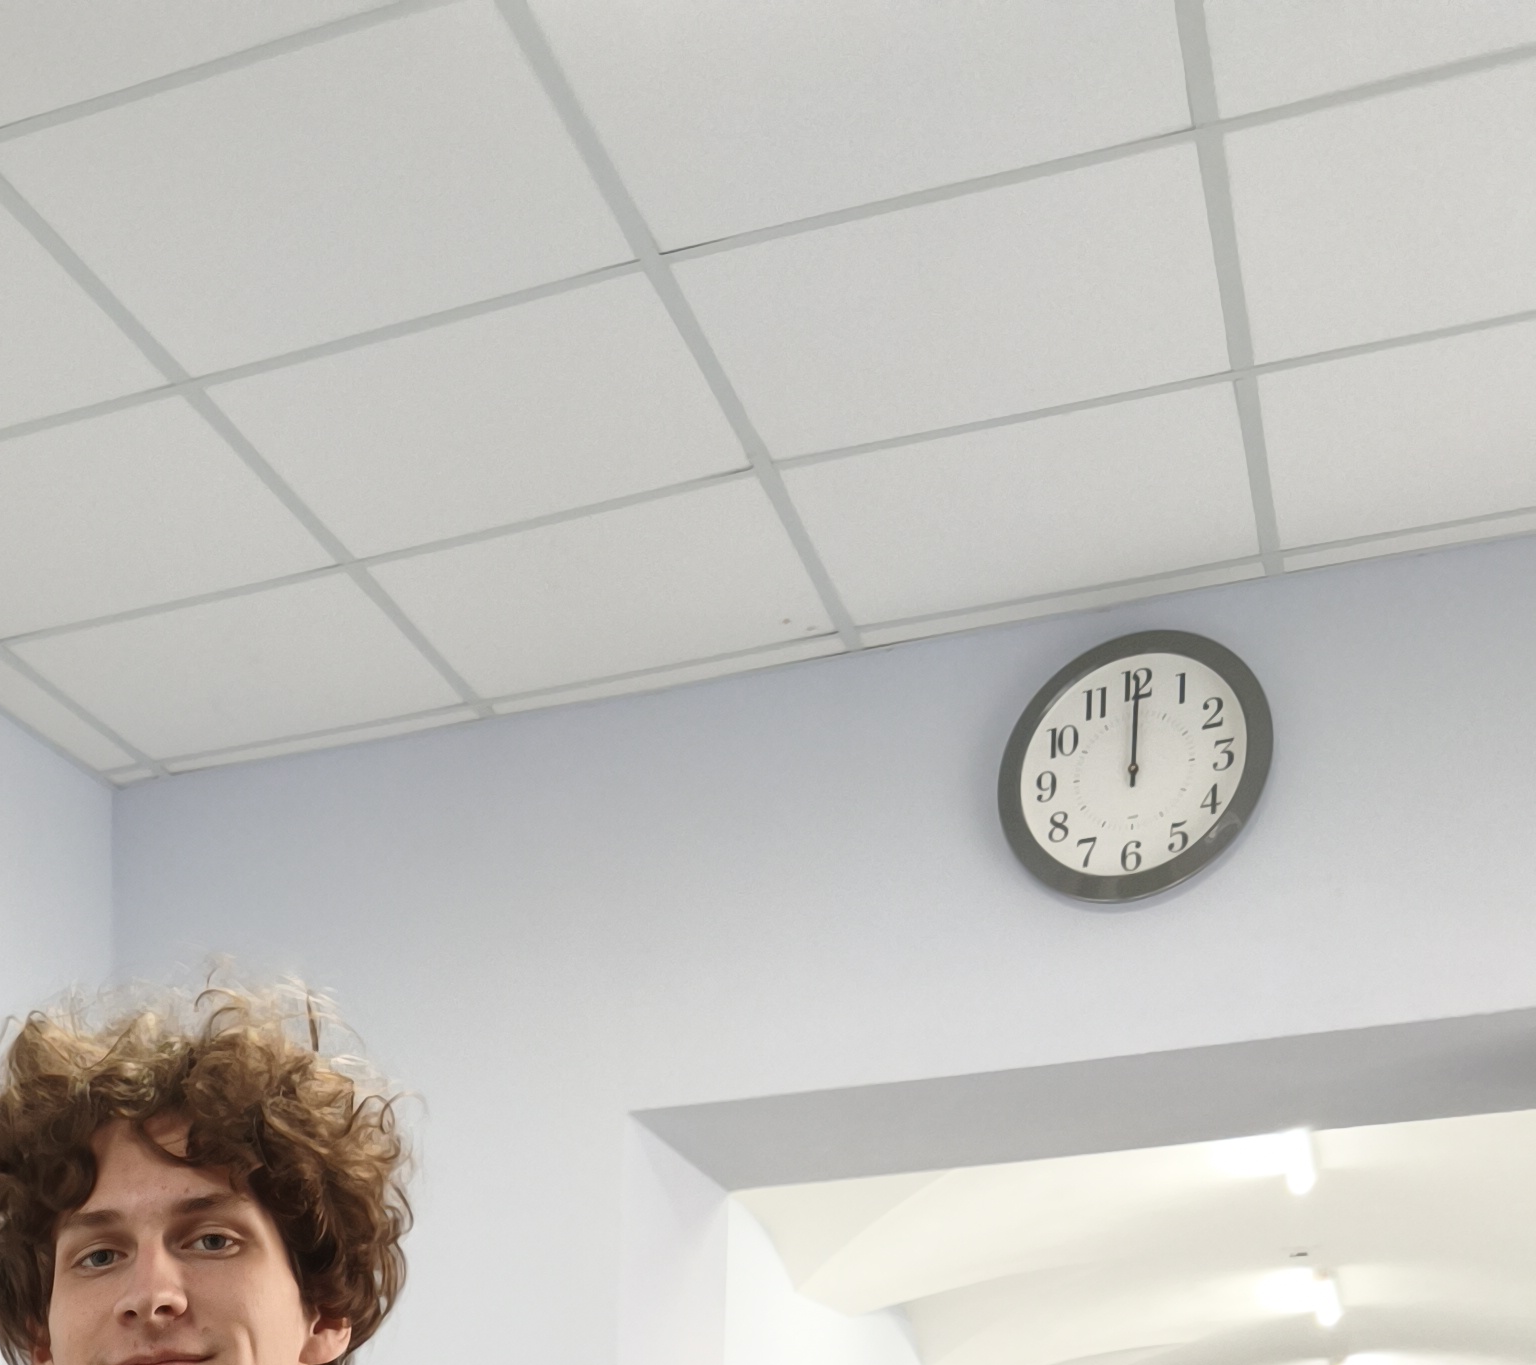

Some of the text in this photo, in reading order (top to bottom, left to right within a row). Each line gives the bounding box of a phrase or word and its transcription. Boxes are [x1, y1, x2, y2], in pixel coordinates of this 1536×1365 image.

[1121, 667, 1153, 702] 12
[1175, 672, 1187, 704] 1
[1082, 686, 1108, 721] 11
[1201, 697, 1224, 730] 2
[1046, 724, 1079, 758] 10
[1212, 737, 1235, 771] 3
[1036, 771, 1057, 802] 9
[1200, 783, 1222, 815] 4
[1048, 811, 1069, 842] 8
[1168, 820, 1189, 853] 5
[1076, 836, 1097, 868] 7
[1120, 840, 1142, 871] 6
